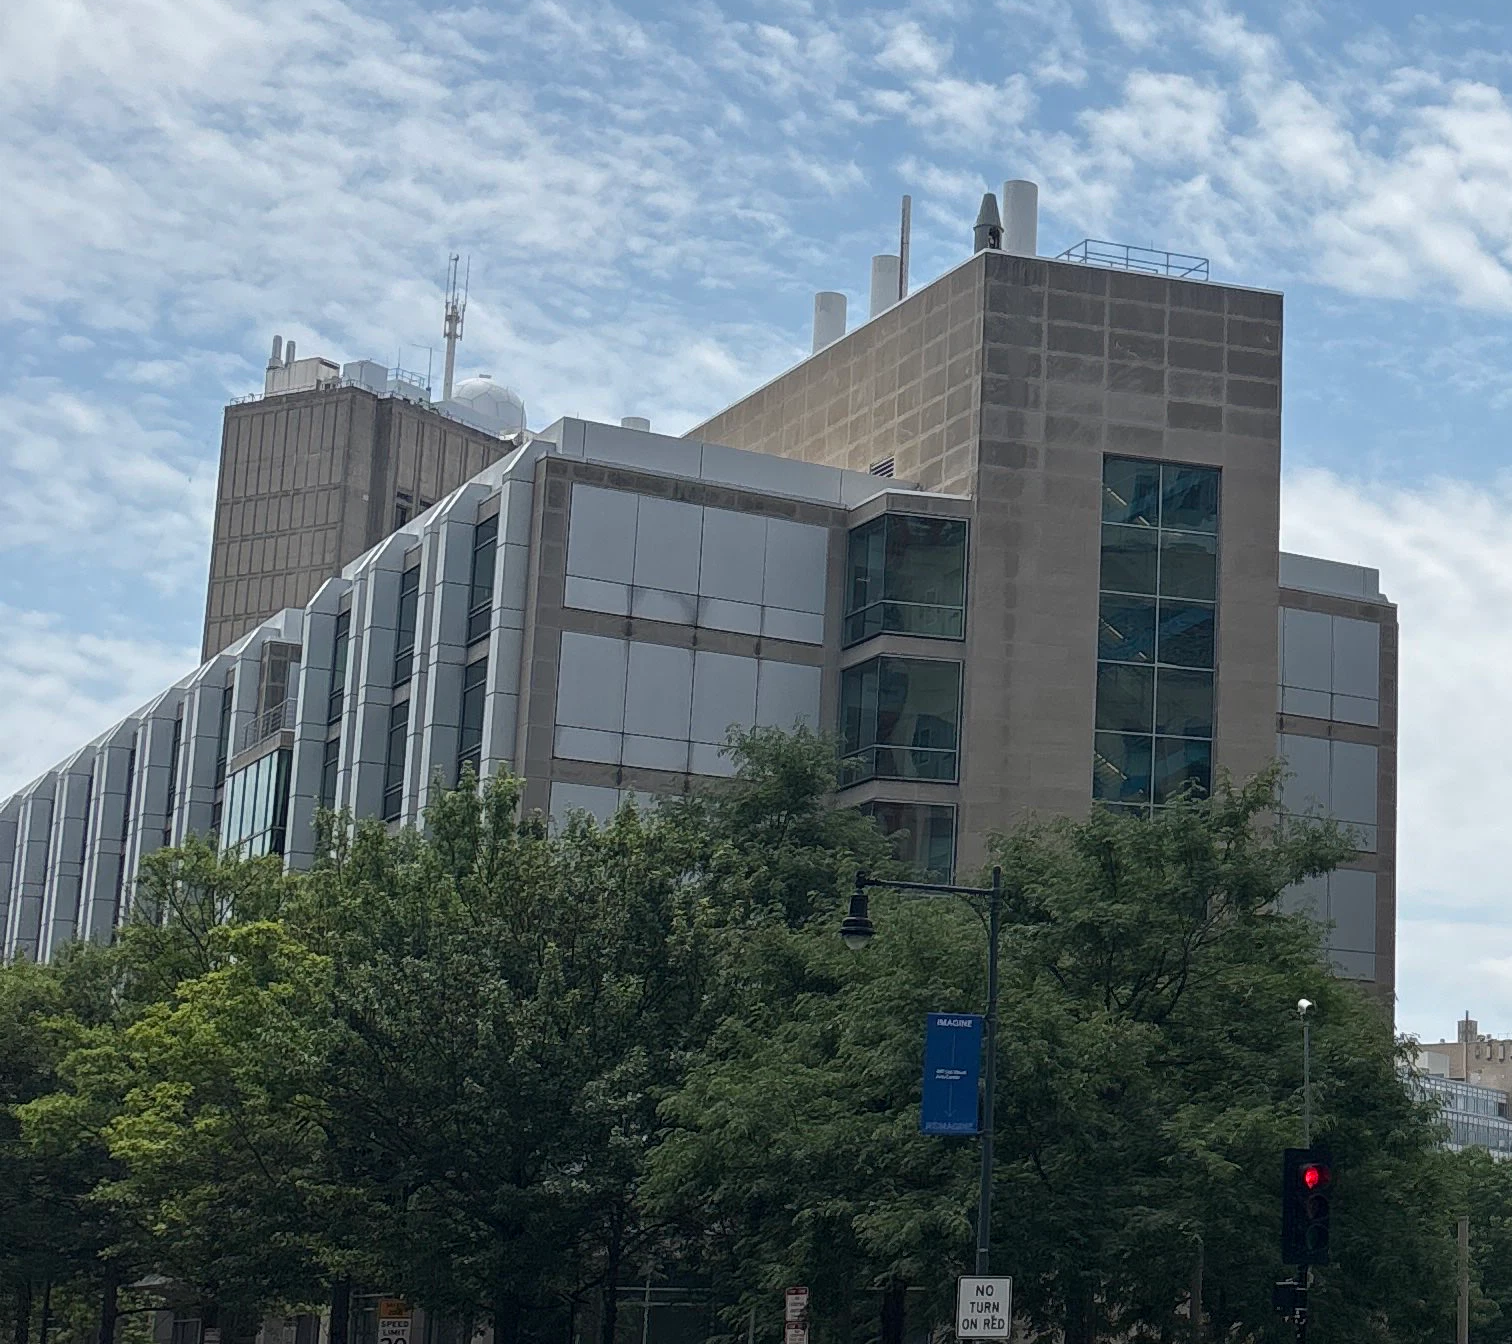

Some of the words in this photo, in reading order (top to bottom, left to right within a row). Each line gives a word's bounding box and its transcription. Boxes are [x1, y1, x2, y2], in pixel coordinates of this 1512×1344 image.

[976, 1285, 994, 1297] NO
[970, 1302, 1000, 1313] TURN
[962, 1318, 978, 1330] ON
[983, 1318, 1005, 1330] RED
